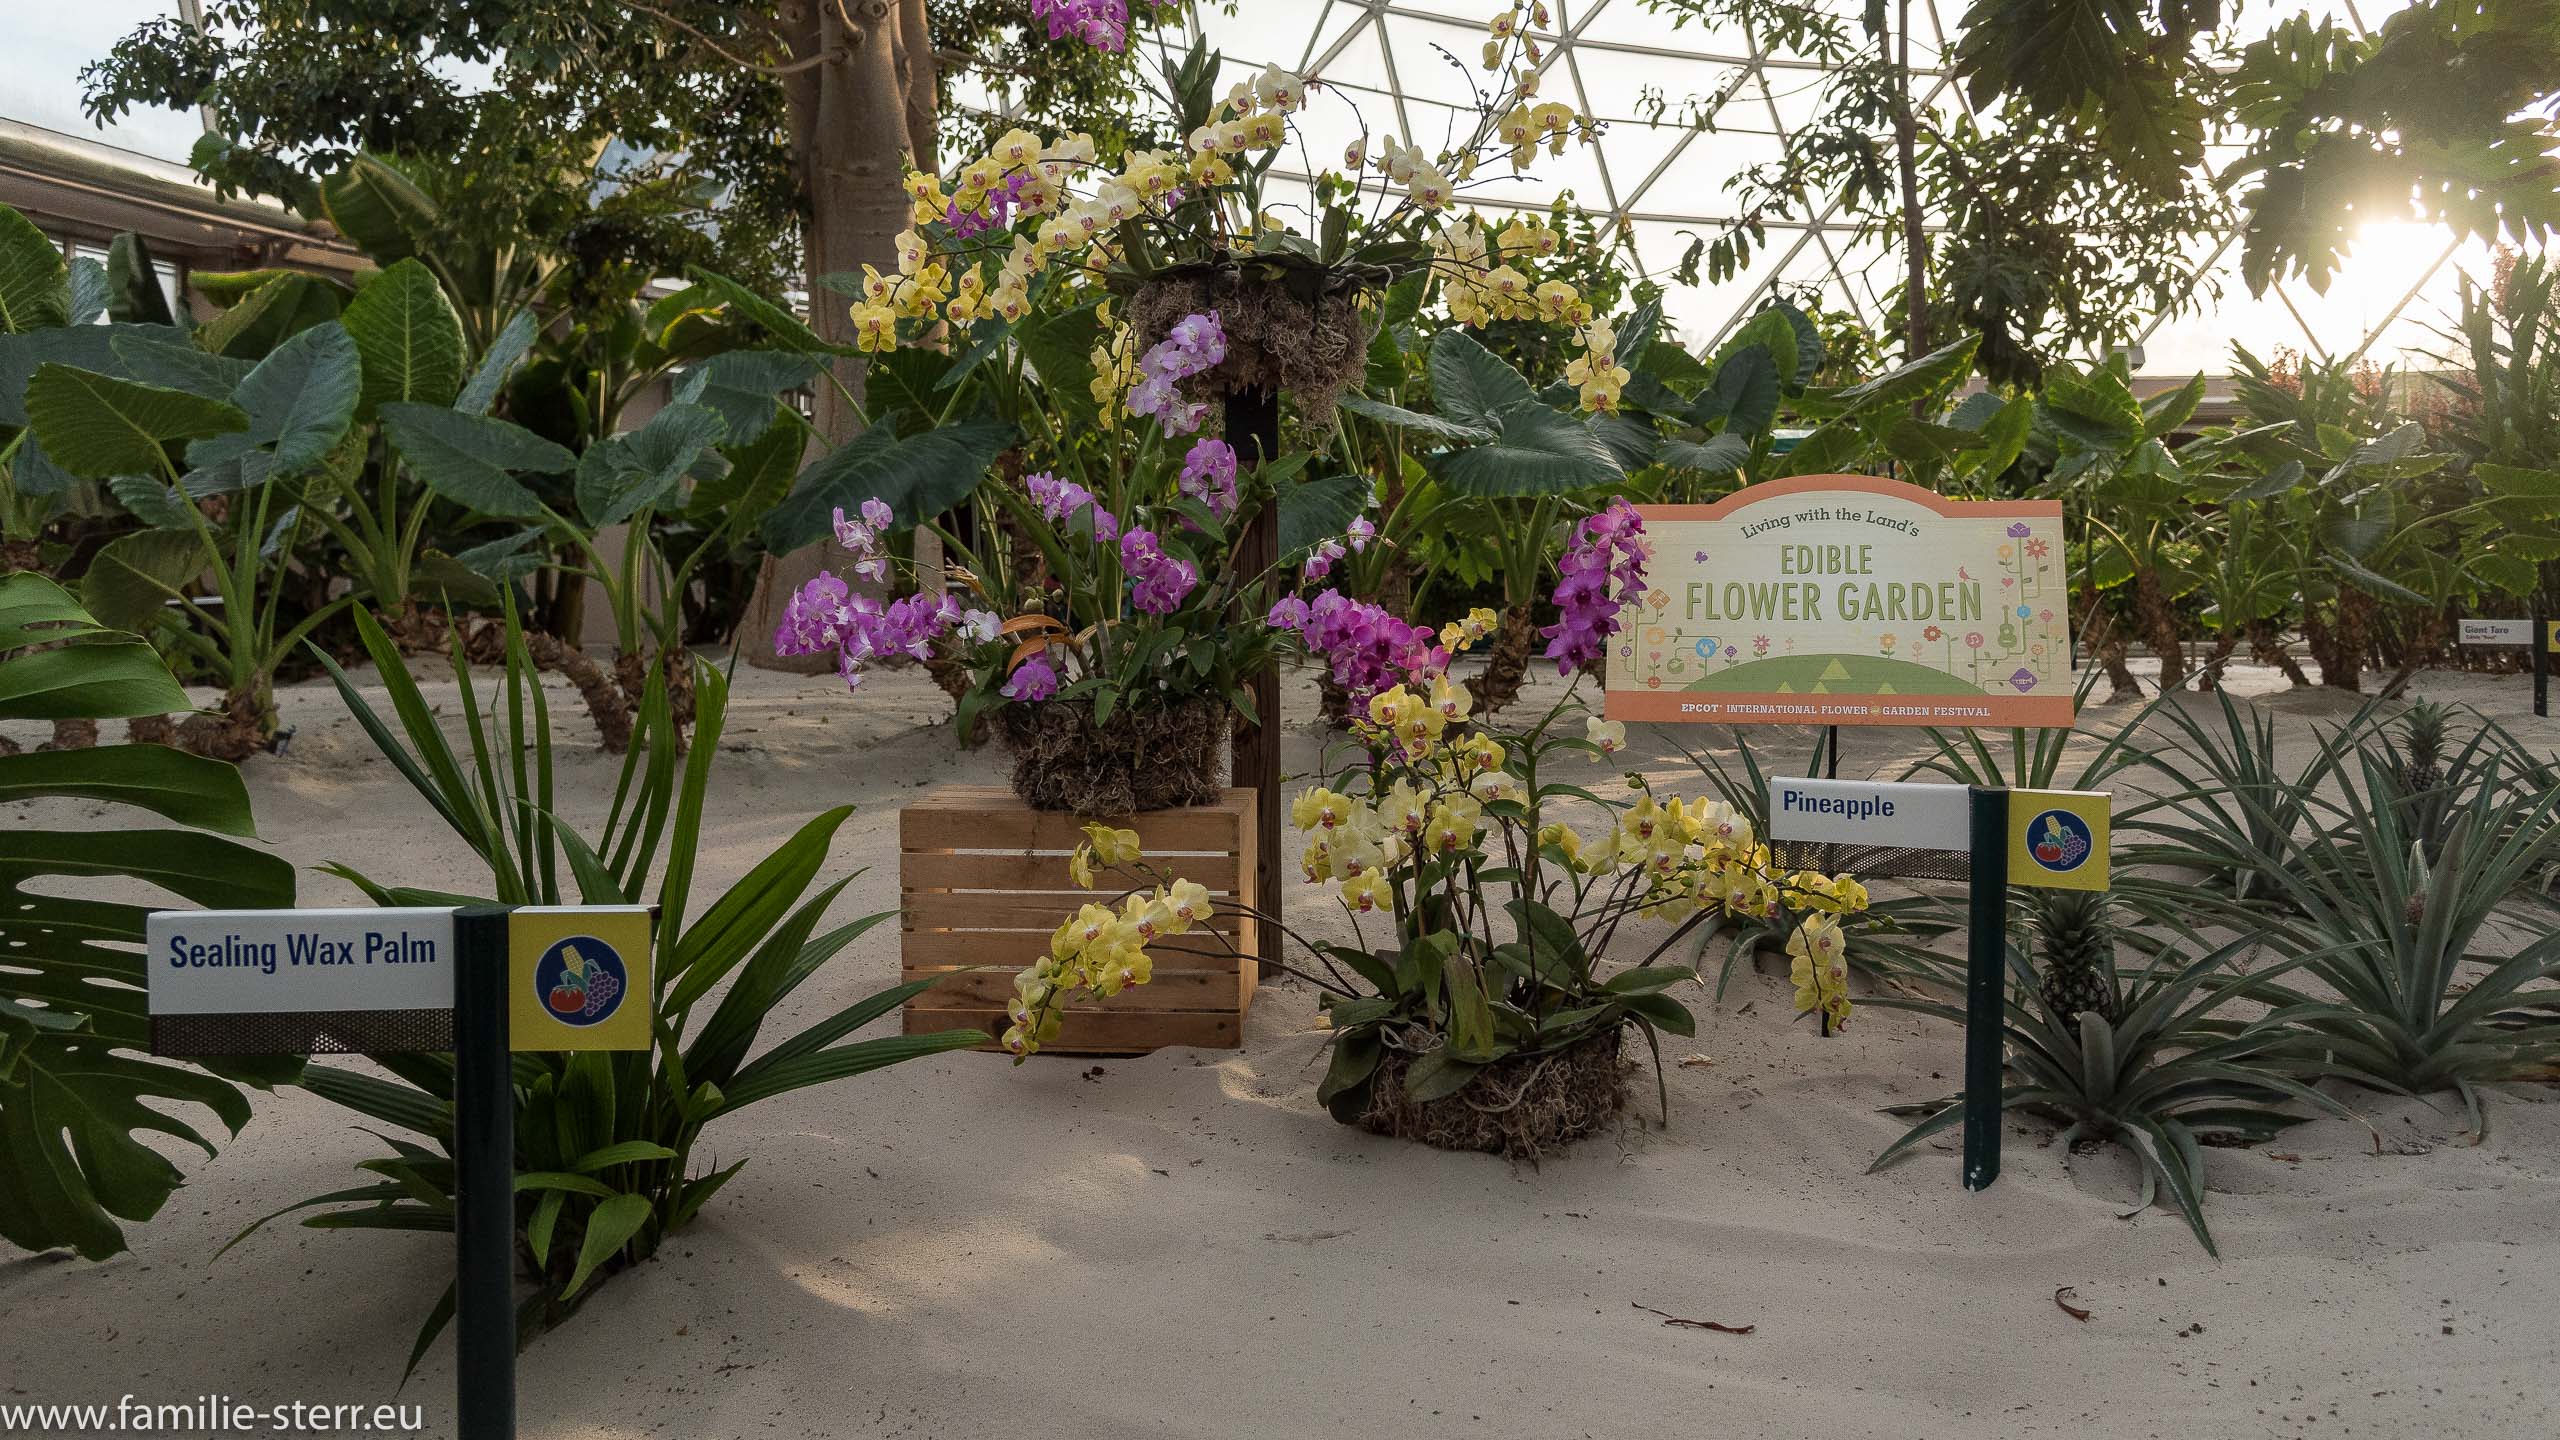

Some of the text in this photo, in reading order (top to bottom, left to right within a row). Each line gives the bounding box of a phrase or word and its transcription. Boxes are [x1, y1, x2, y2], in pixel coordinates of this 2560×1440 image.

[1740, 507, 1920, 539] Living with the Land's
[1780, 544, 1873, 575] EDIBLE
[1685, 582, 1983, 622] FLOWER GARDEN
[2464, 625, 2509, 635] Giant Taro
[1726, 704, 1818, 715] INTERNATIONAL
[1820, 705, 1868, 716] FLOWER
[1882, 706, 1930, 717] GARDEN
[1933, 706, 1991, 718] FESTIVAL
[1783, 789, 1896, 821] Pineapple
[169, 931, 437, 975] Sealing Wax Palm
